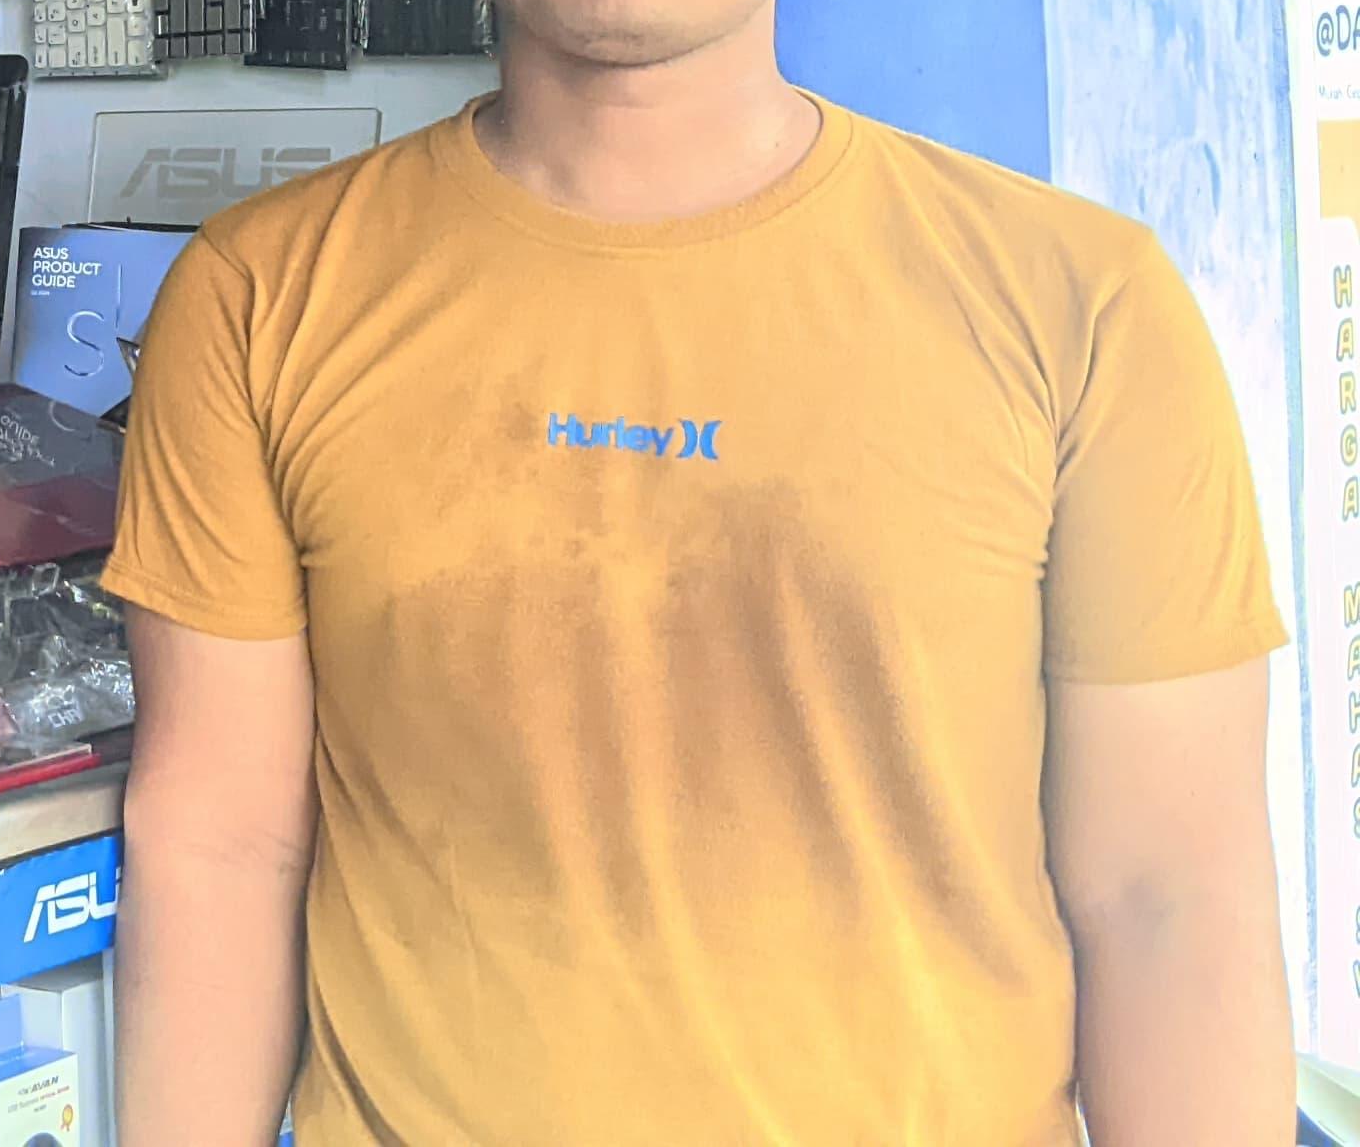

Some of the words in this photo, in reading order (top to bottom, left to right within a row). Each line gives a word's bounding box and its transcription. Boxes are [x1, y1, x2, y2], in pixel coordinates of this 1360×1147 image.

[34, 247, 69, 261] ASUS
[33, 260, 102, 276] PRODUCT
[31, 274, 77, 289] GUIDE
[547, 412, 675, 458] Hurley
[23, 867, 120, 944] ASU
